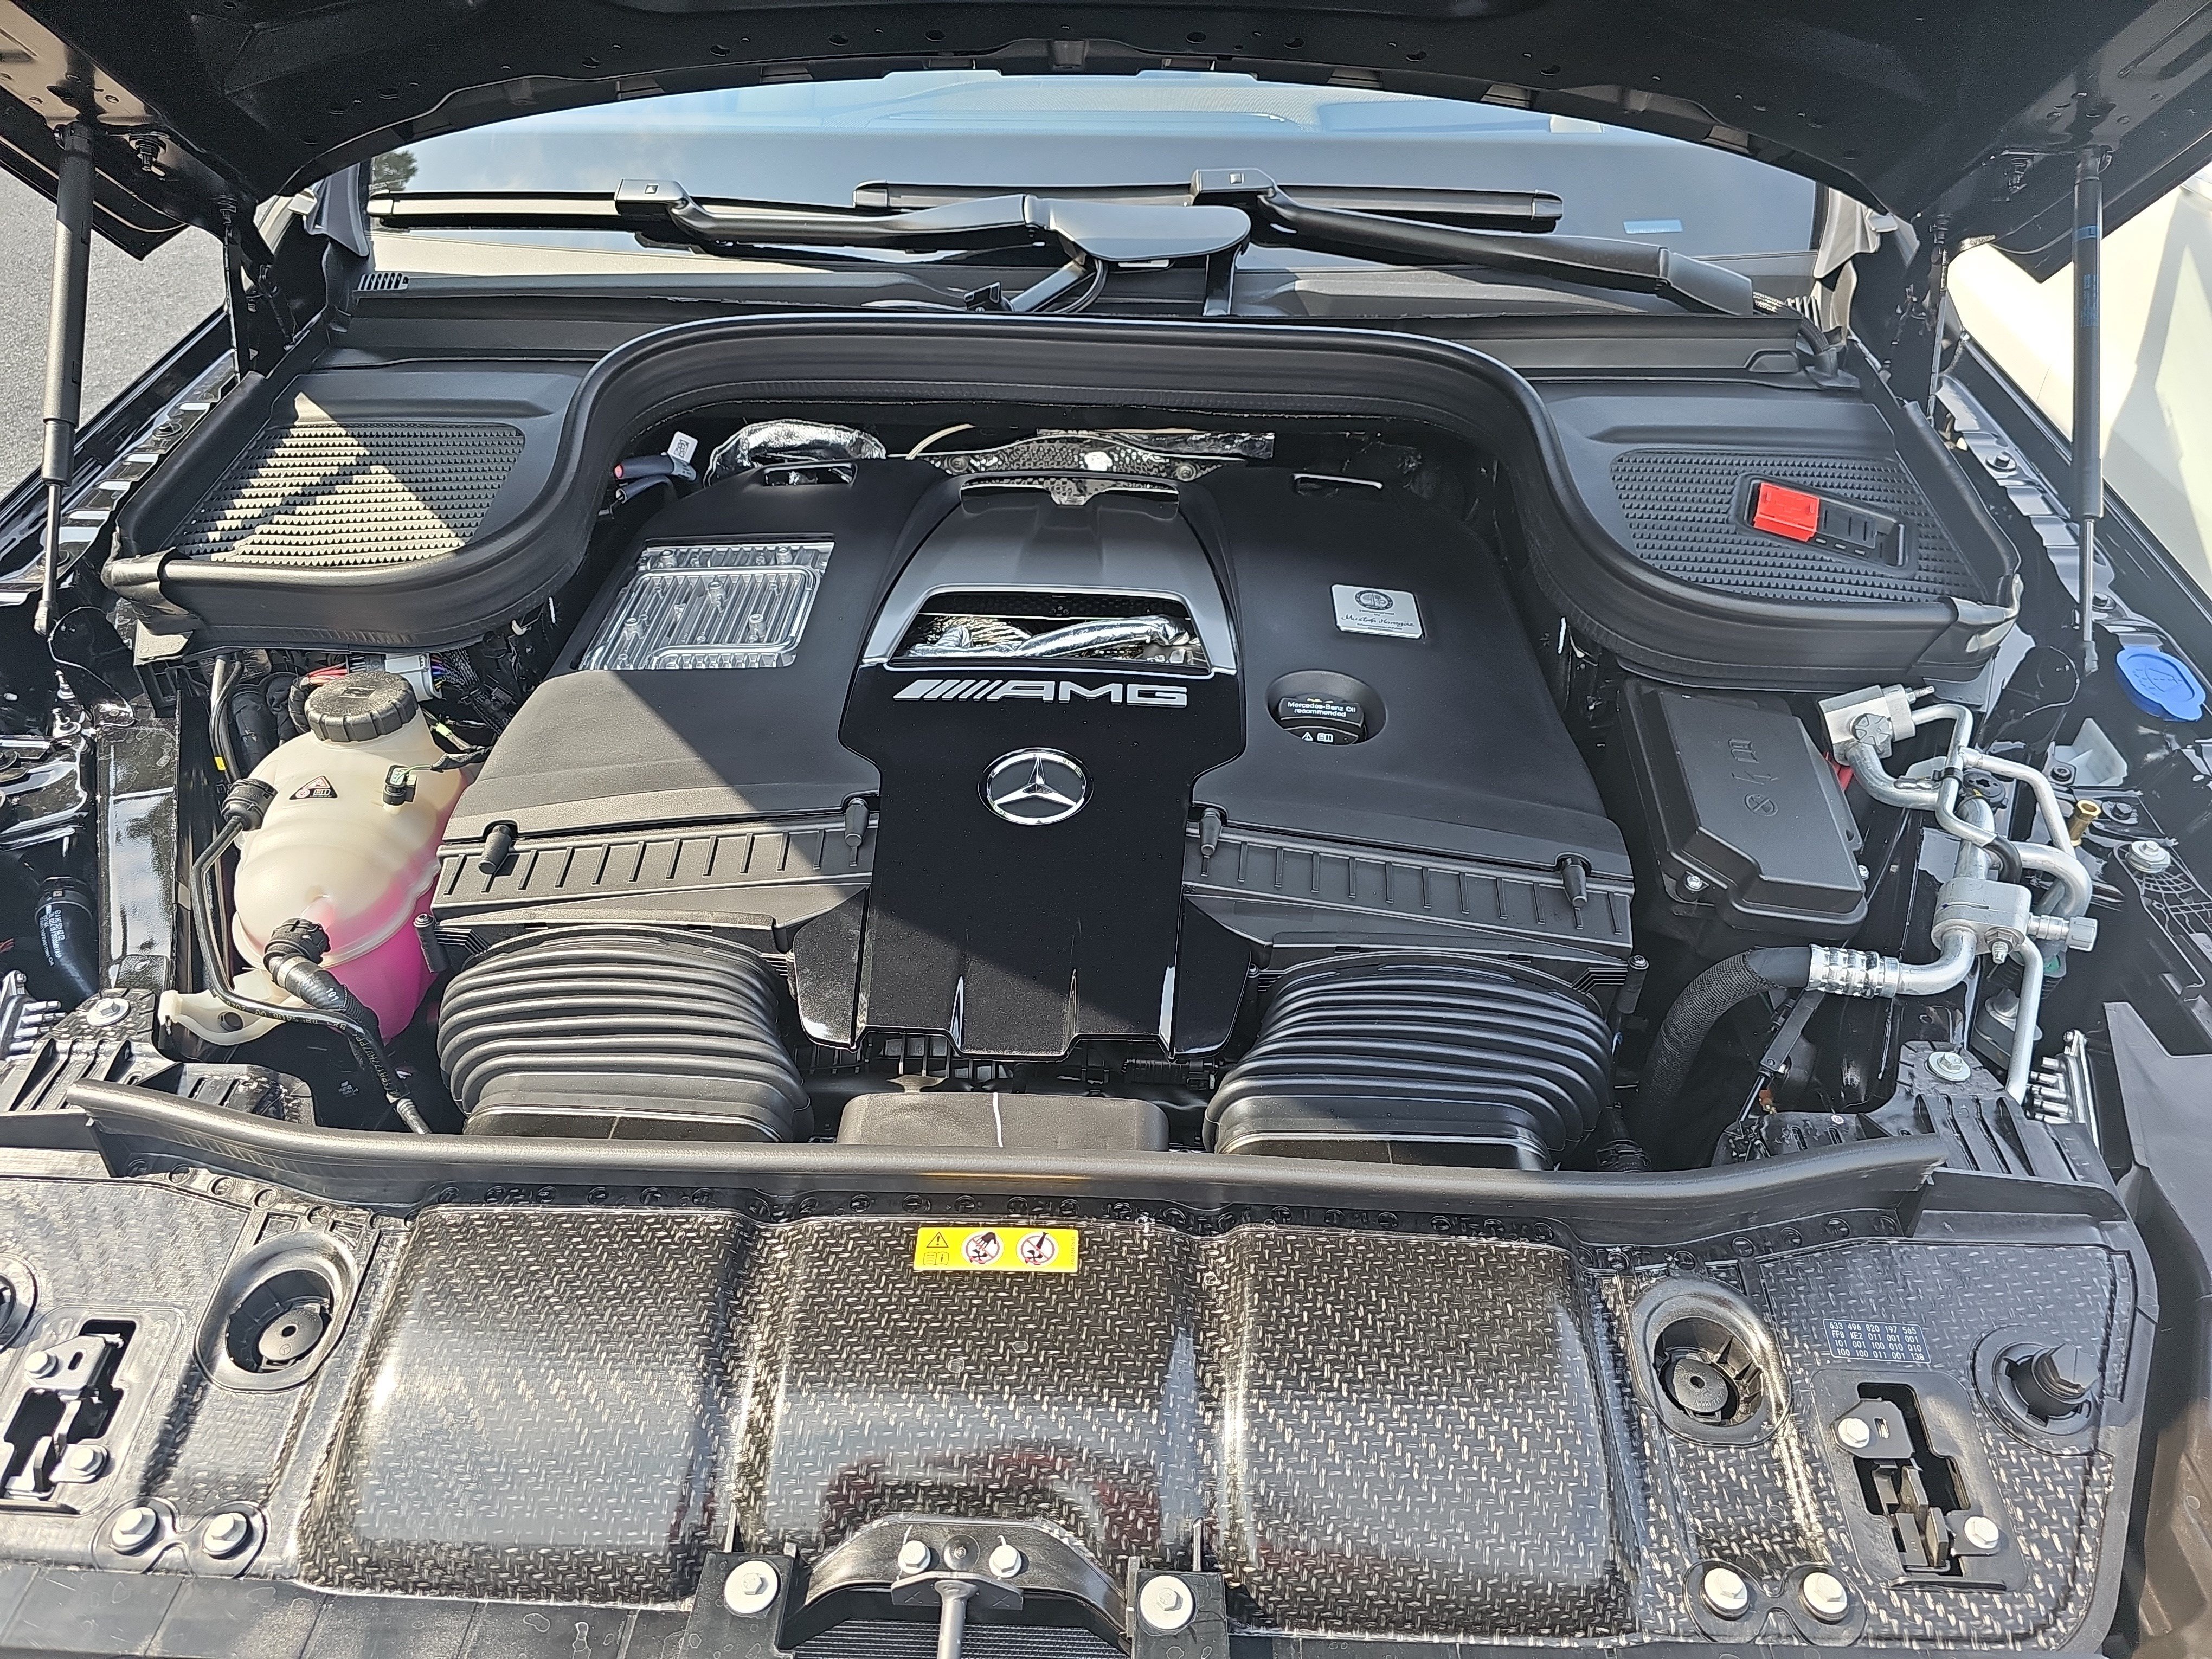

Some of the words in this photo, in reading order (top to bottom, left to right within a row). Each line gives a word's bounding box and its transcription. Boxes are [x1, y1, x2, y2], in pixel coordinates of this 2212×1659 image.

[986, 679, 1187, 707] AMG
[1287, 702, 1344, 711] Mercedes-Benz
[1294, 708, 1346, 717] recommended
[325, 988, 339, 1002] 101
[1850, 1332, 1863, 1340] KE2
[1892, 1352, 1905, 1360] 001
